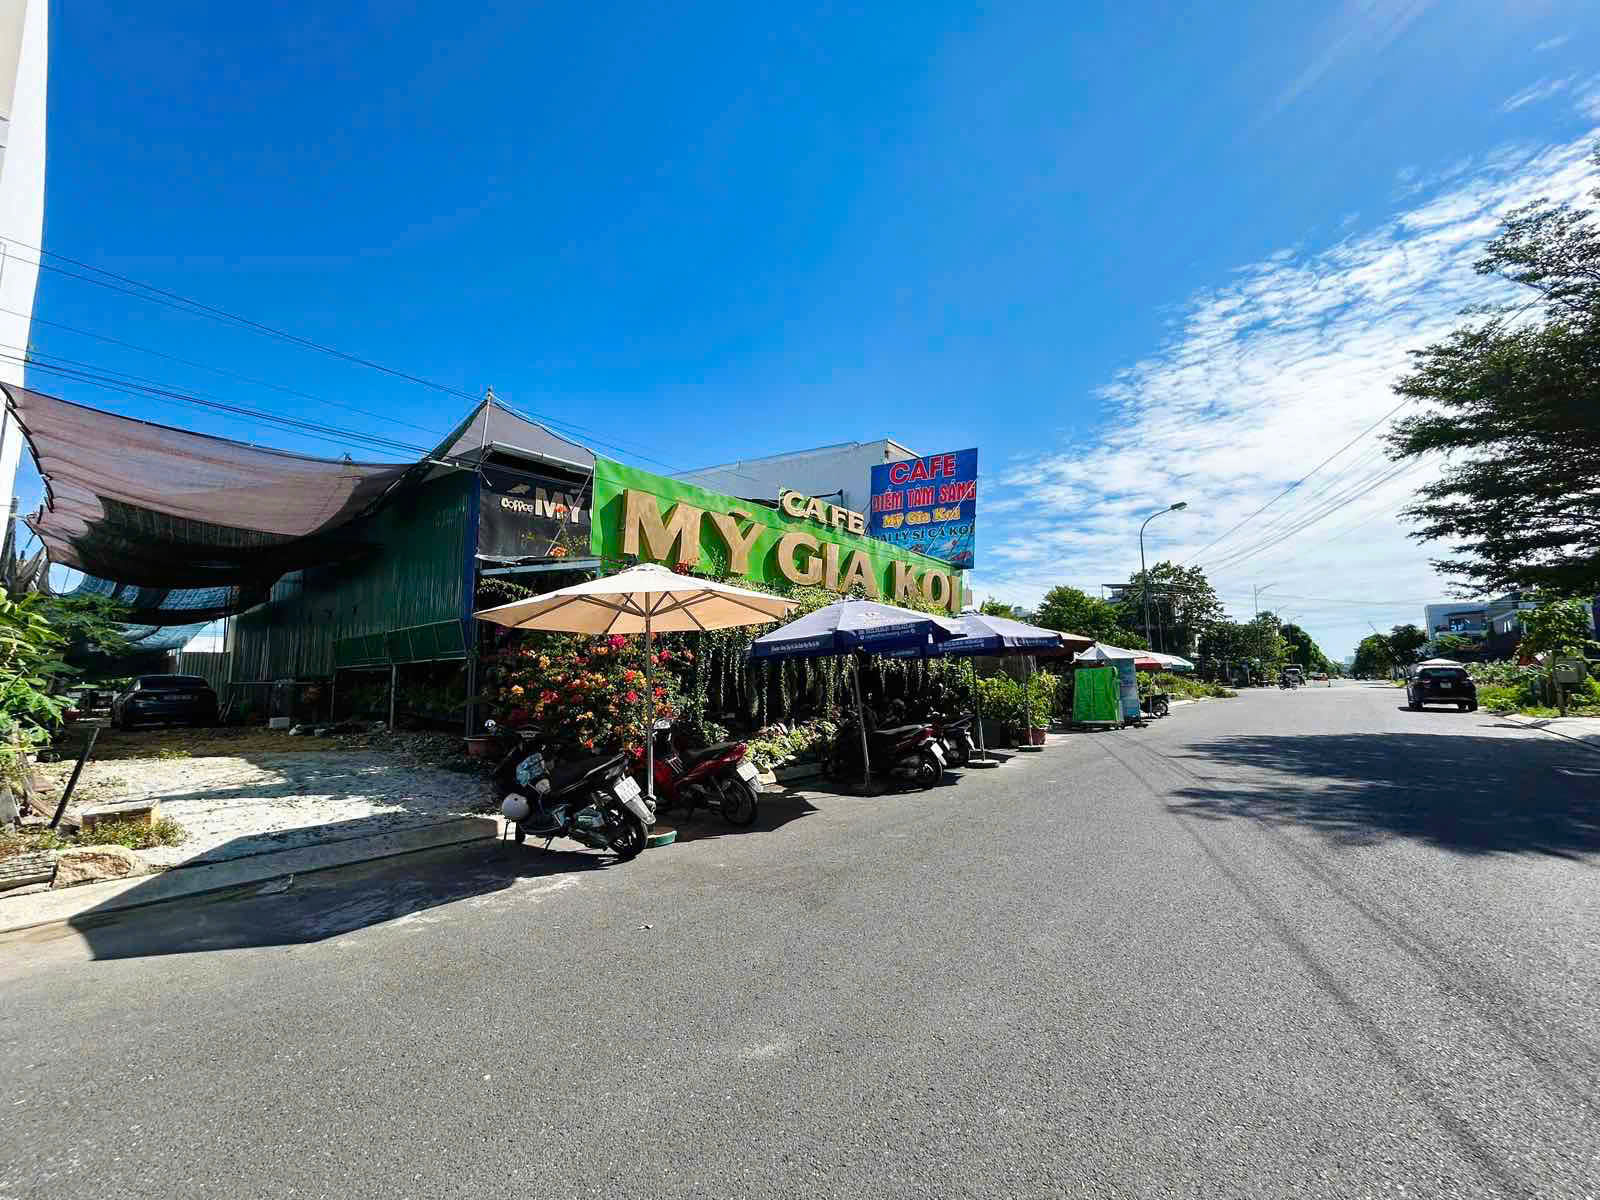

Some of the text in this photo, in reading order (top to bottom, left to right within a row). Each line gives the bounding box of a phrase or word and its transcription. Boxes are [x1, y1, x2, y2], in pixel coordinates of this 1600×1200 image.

[889, 454, 956, 485] CAFE
[782, 490, 865, 536] CAFE
[778, 532, 881, 598] GIA
[894, 560, 961, 613] KOI
